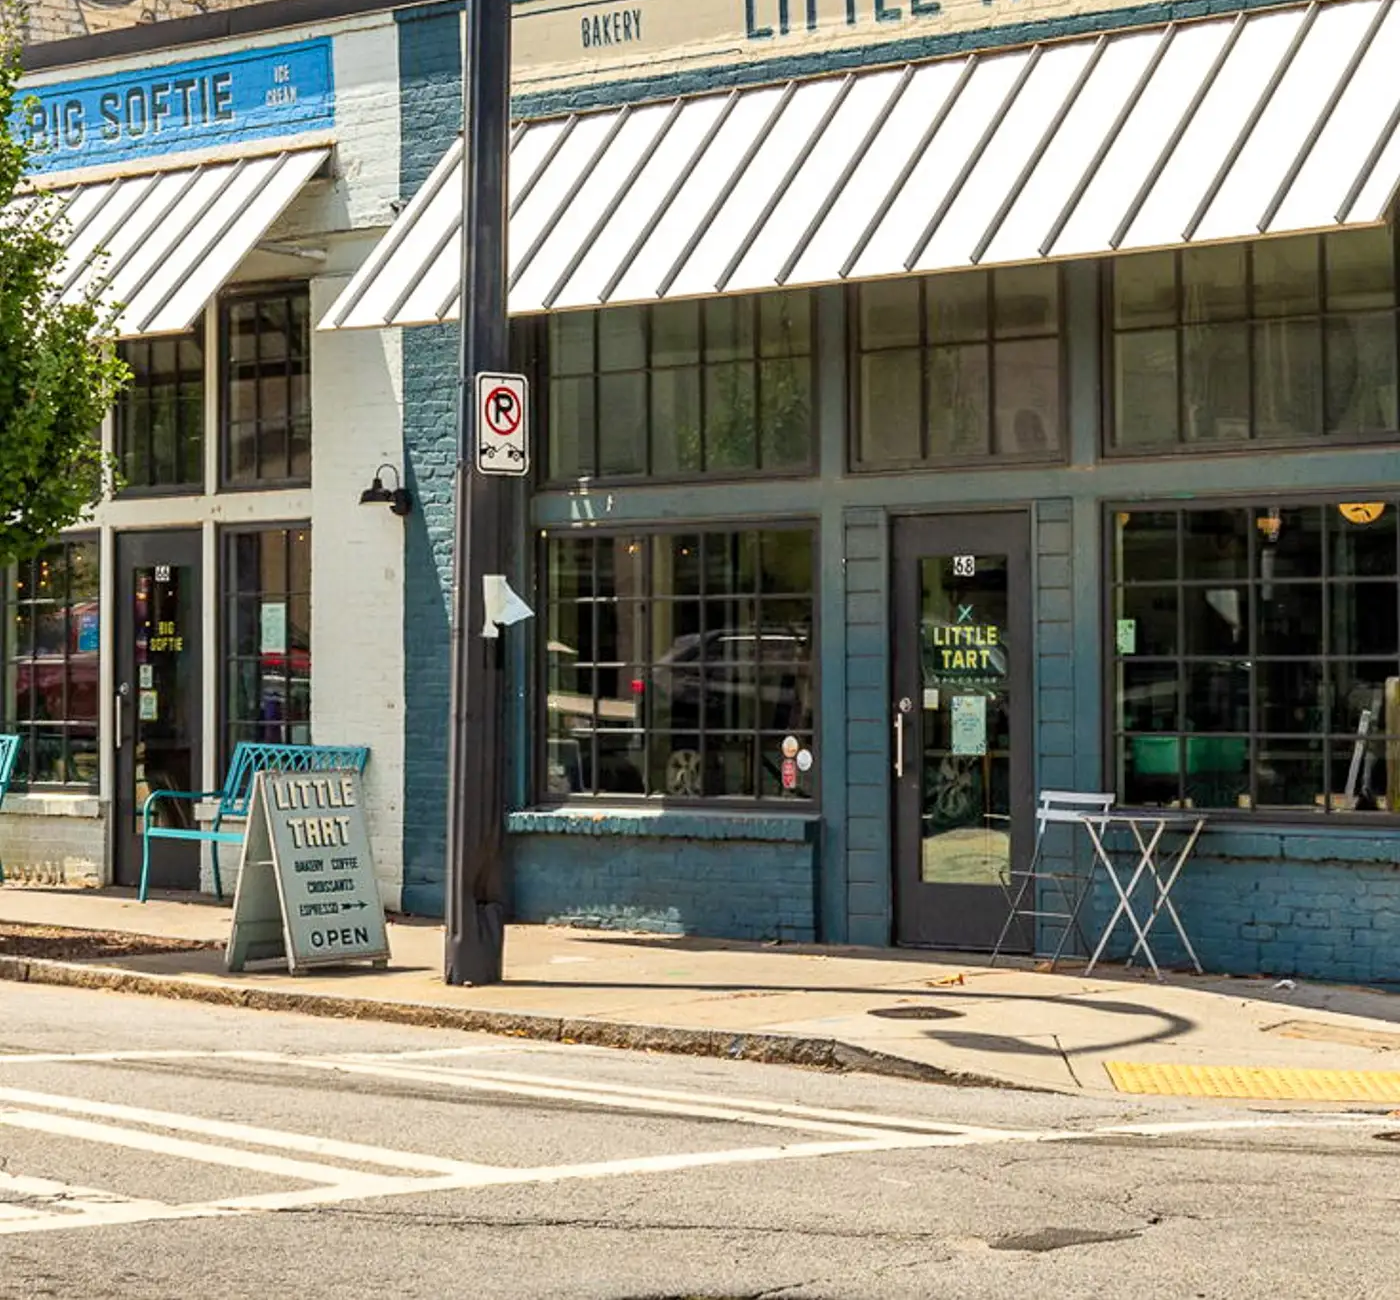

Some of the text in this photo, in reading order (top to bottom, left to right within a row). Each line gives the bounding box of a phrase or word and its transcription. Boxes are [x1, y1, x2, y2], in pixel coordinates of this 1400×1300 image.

[582, 9, 641, 48] BAKERY
[100, 71, 235, 144] SOFTIE
[954, 556, 975, 576] 68
[158, 621, 175, 635] BIG
[933, 626, 998, 646] LITTLE
[941, 649, 990, 669] TART
[273, 777, 356, 810] LITTLE
[287, 816, 350, 848] TART
[331, 857, 359, 870] COFFEE
[299, 902, 339, 916] ESPRESSO
[311, 927, 369, 947] OPEN
